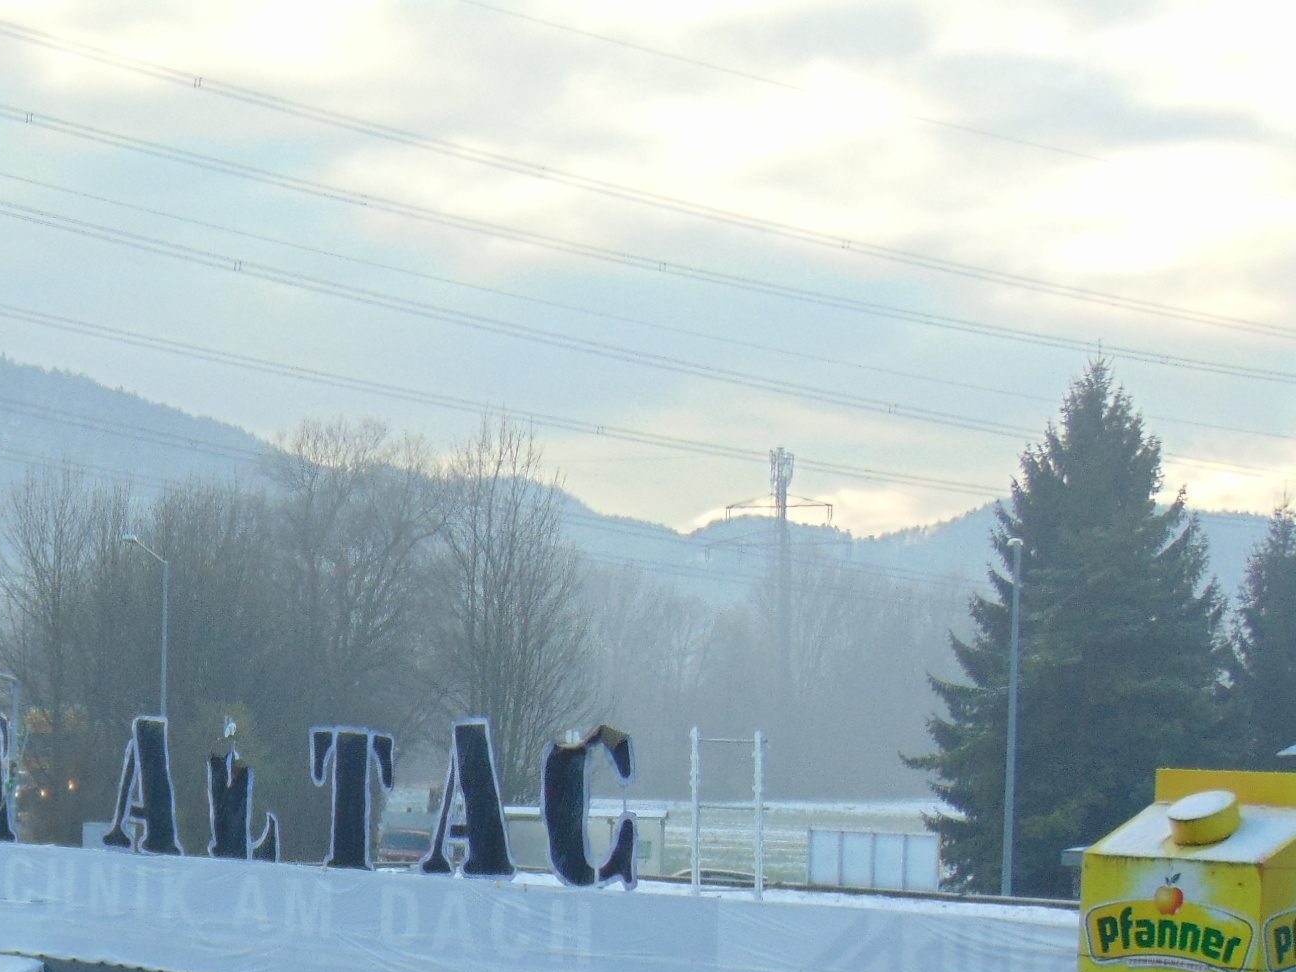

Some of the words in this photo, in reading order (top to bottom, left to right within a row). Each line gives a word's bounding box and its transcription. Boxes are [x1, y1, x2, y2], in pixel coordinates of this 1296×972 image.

[231, 874, 334, 938] AM
[380, 884, 594, 966] DACH
[1097, 906, 1242, 965] pfanner
